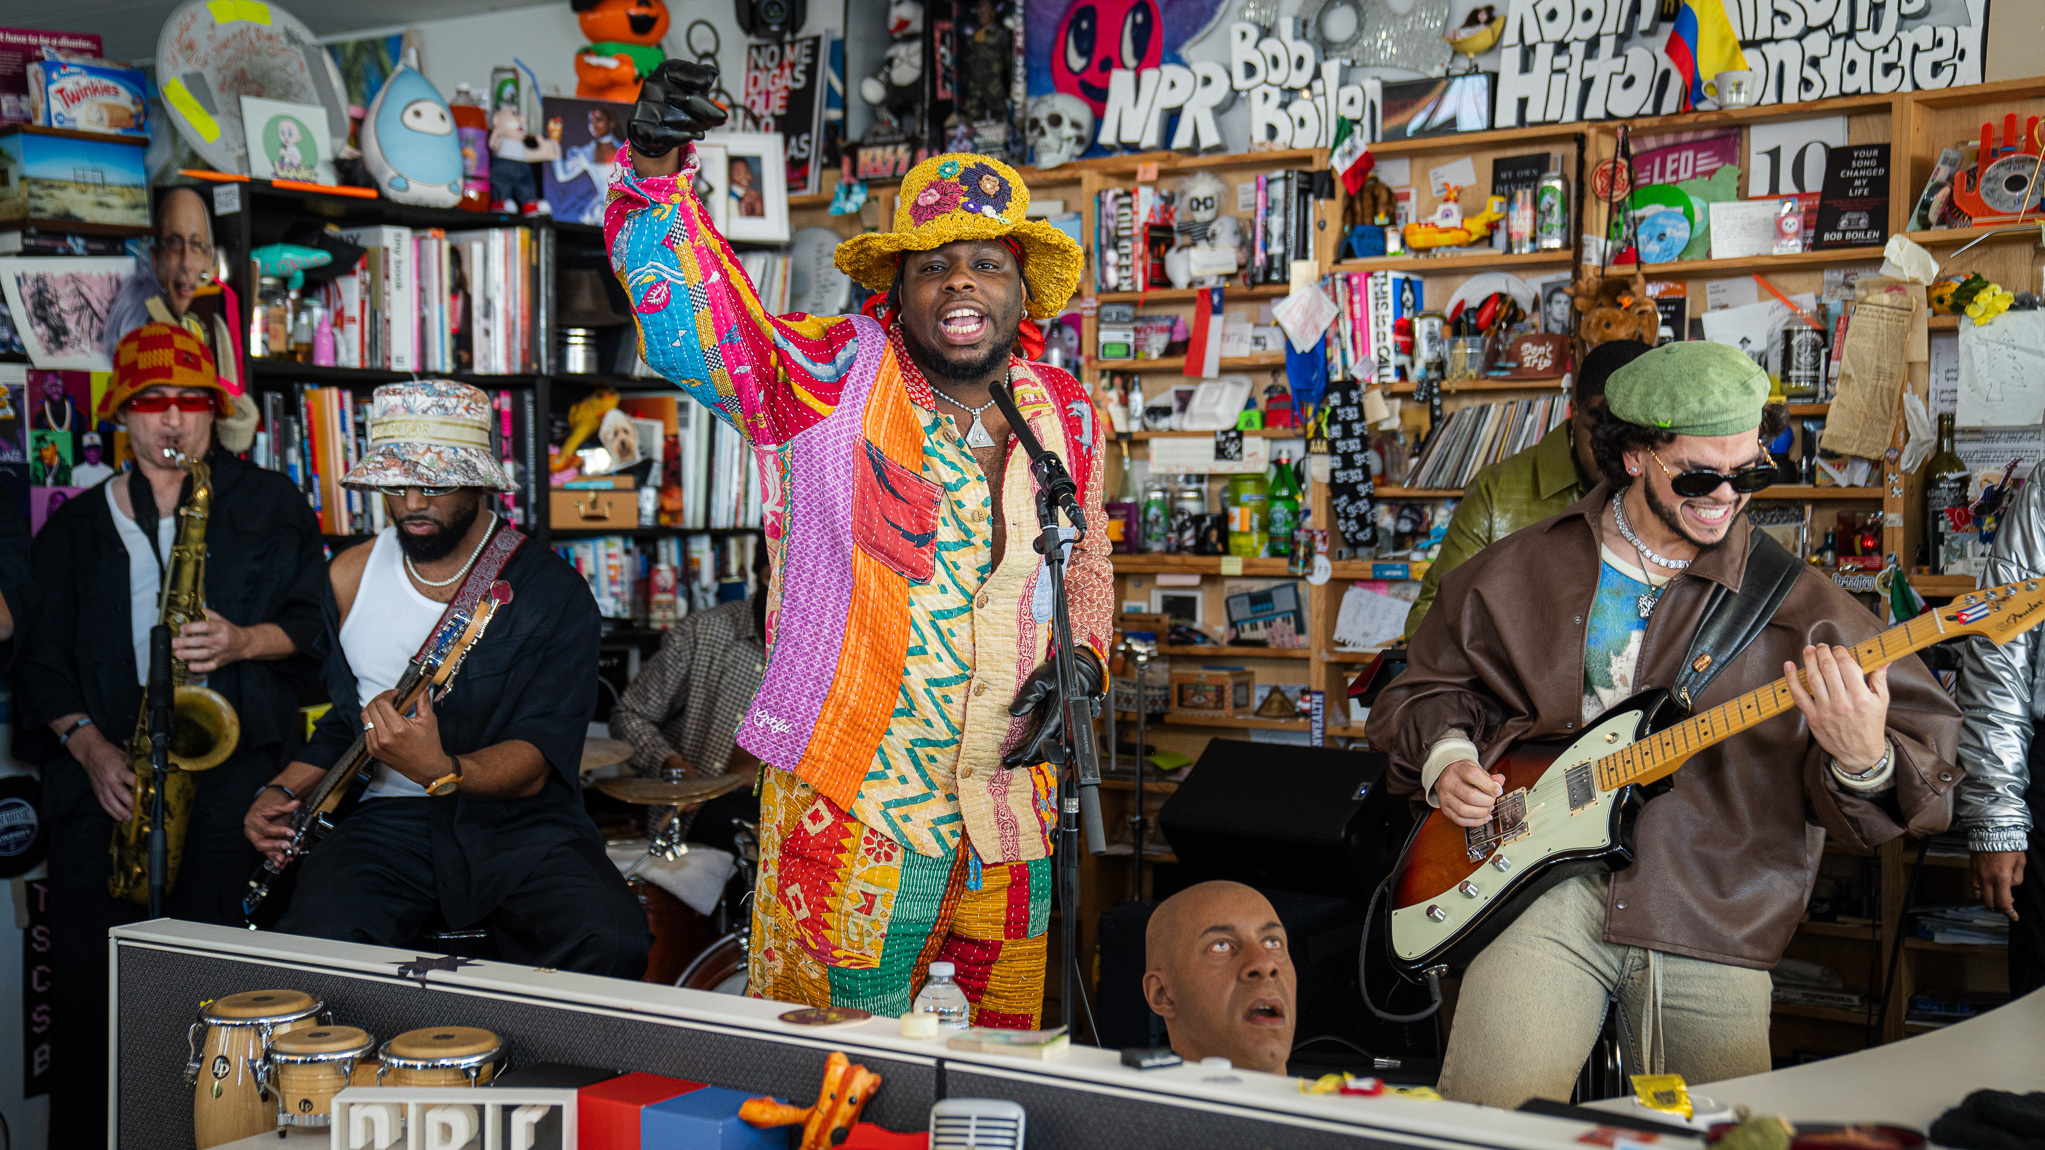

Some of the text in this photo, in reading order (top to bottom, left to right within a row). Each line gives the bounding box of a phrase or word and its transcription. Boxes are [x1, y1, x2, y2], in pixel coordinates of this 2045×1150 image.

[750, 39, 813, 69] NO ME
[1231, 16, 1315, 90] Bob
[55, 80, 119, 109] Twinkies
[748, 65, 807, 96] DIGAS
[1495, 34, 1683, 128] Hilton
[746, 91, 787, 116] QUE
[1097, 61, 1231, 149] NPR
[1251, 59, 1383, 149] Boilen
[857, 143, 912, 179] KISS
[1653, 150, 1694, 184] LED
[1756, 141, 1833, 196] 10
[1851, 158, 1877, 168] SONG
[1853, 149, 1878, 159] YOUR
[1517, 168, 1539, 178] OWN
[1840, 167, 1885, 178] CHANGED
[1853, 178, 1868, 187] MY
[1849, 187, 1869, 197] LIFE
[1823, 230, 1880, 241] BOB BOILEN
[1377, 346, 1391, 382] CALL
[1521, 341, 1554, 358] Don't
[1523, 356, 1552, 371] Trip
